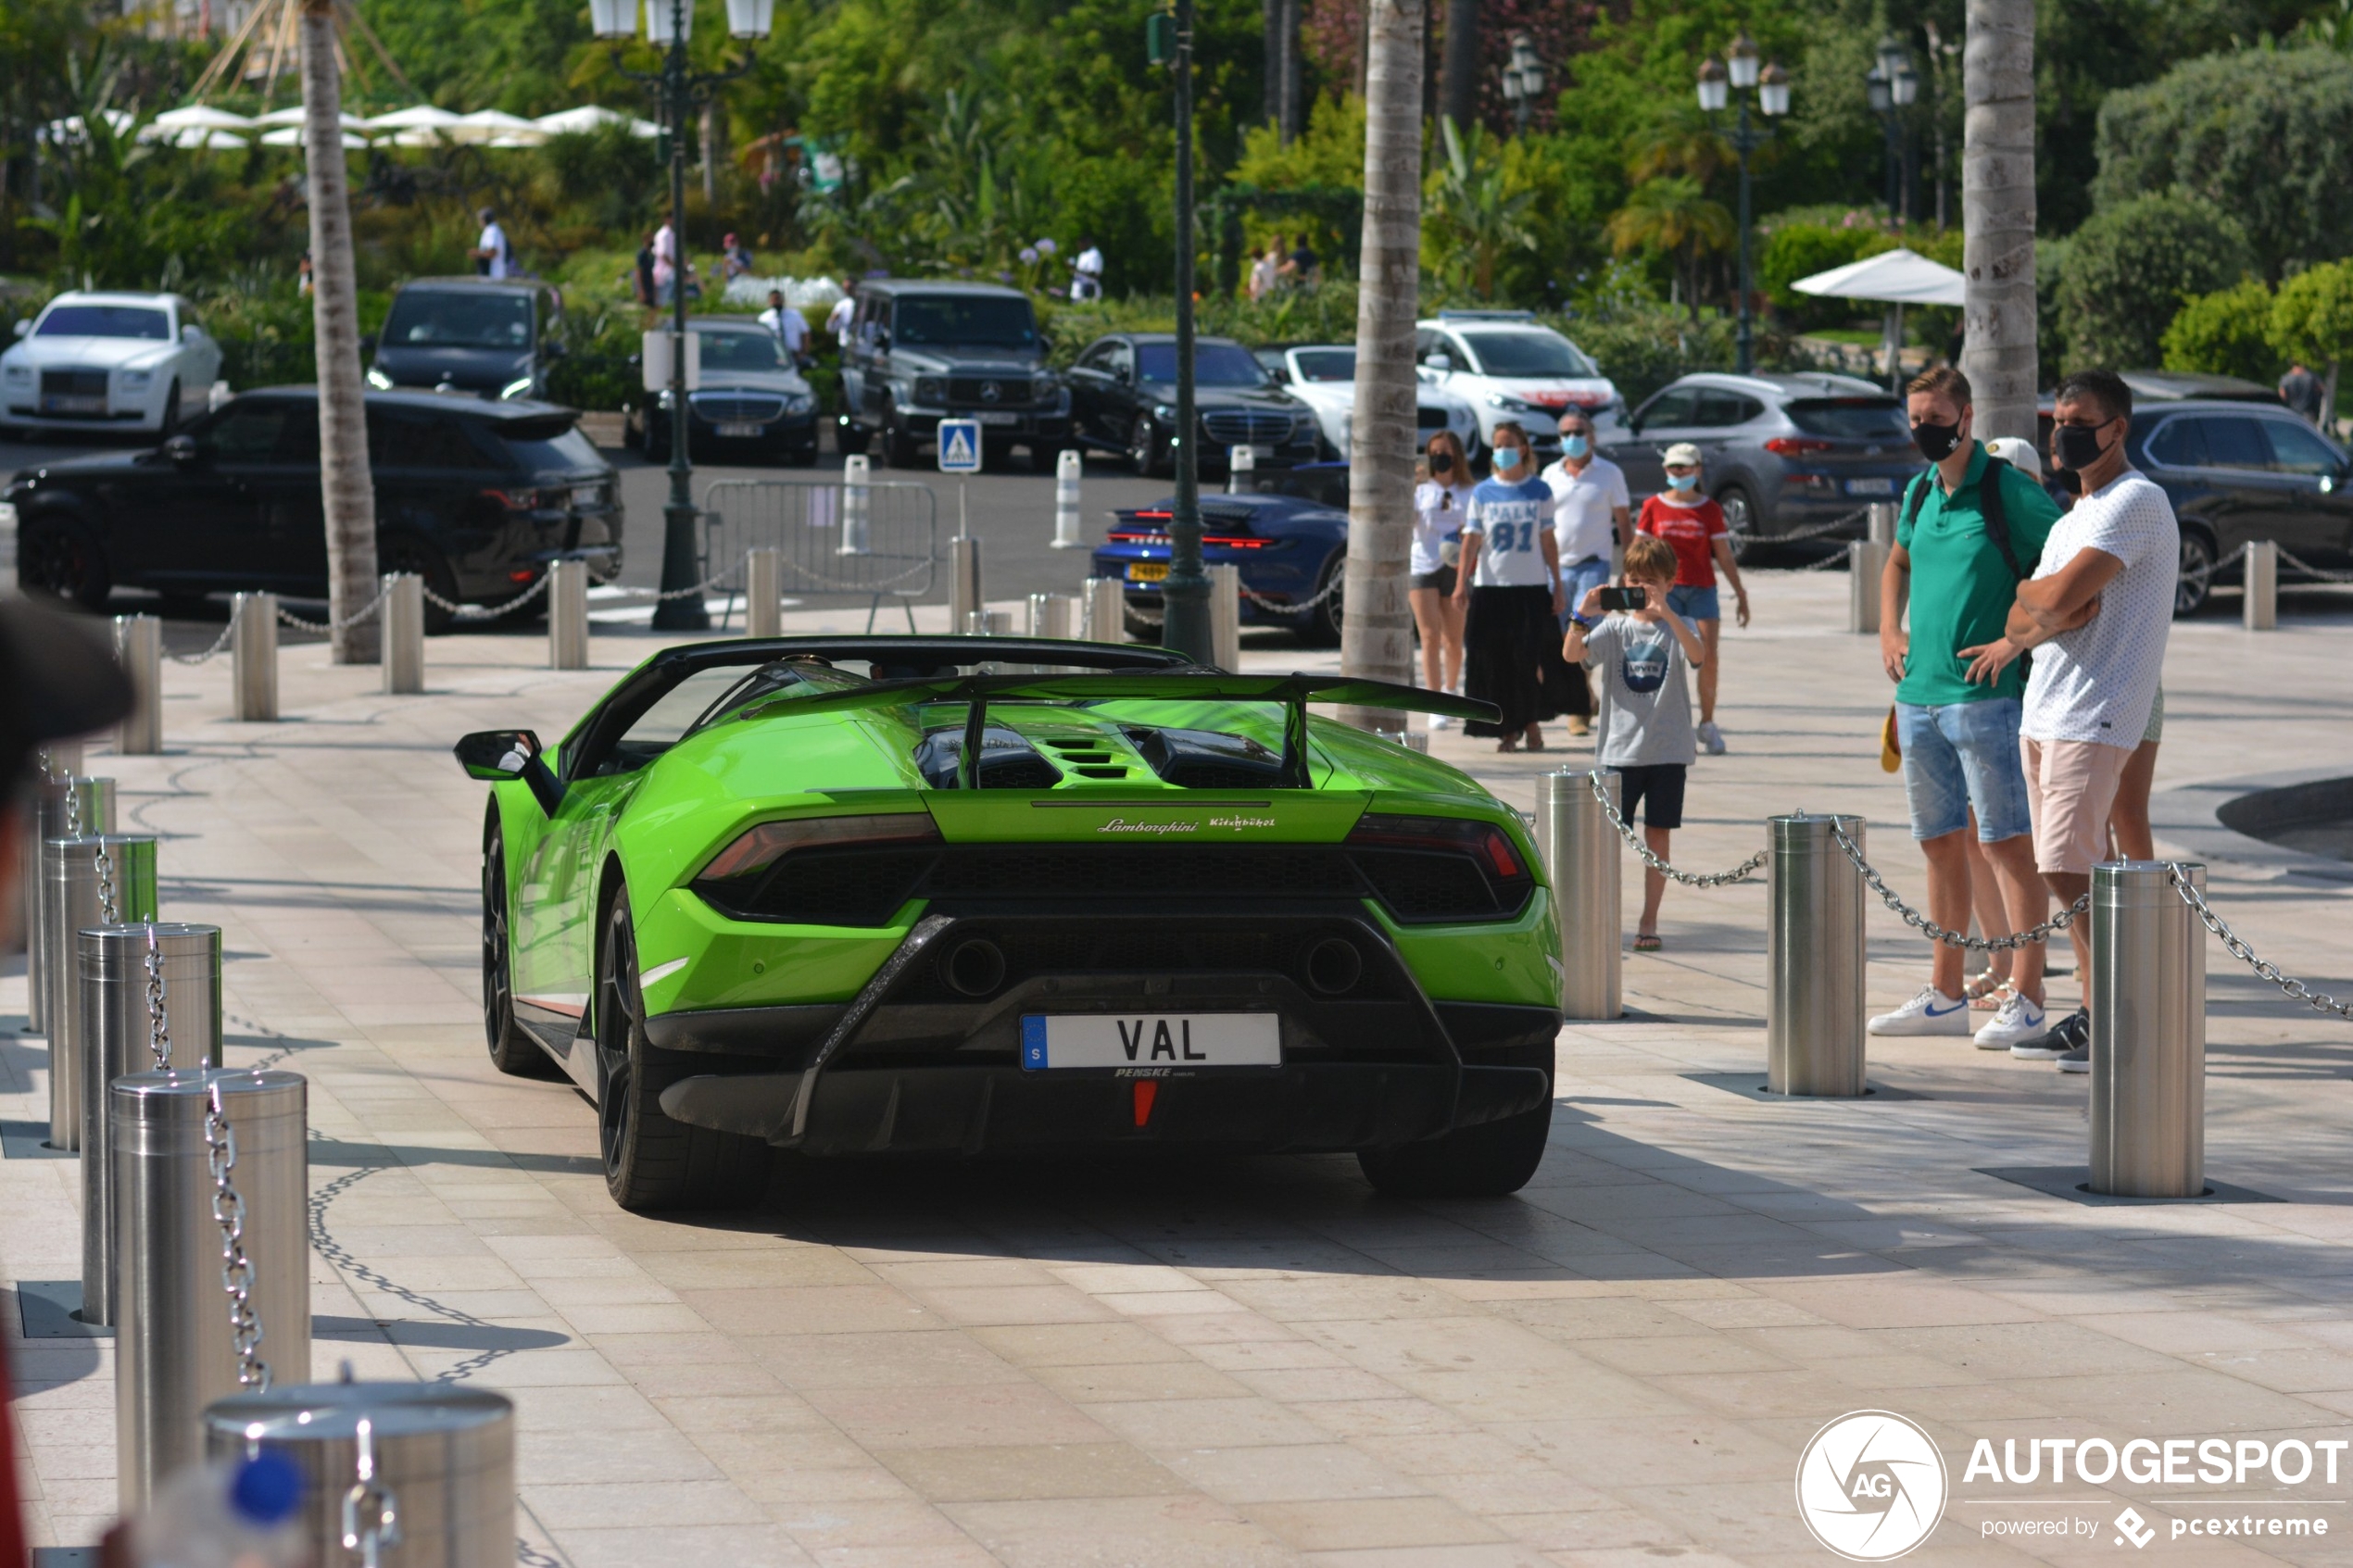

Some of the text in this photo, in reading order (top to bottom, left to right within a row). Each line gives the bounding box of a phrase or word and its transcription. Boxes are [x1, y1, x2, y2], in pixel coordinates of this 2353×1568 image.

[1491, 521, 1533, 554] 81
[1097, 818, 1200, 835] Lamborghini
[1116, 1019, 1207, 1061] VAL
[1031, 1047, 1040, 1060] S
[1114, 1068, 1172, 1077] PENSKE
